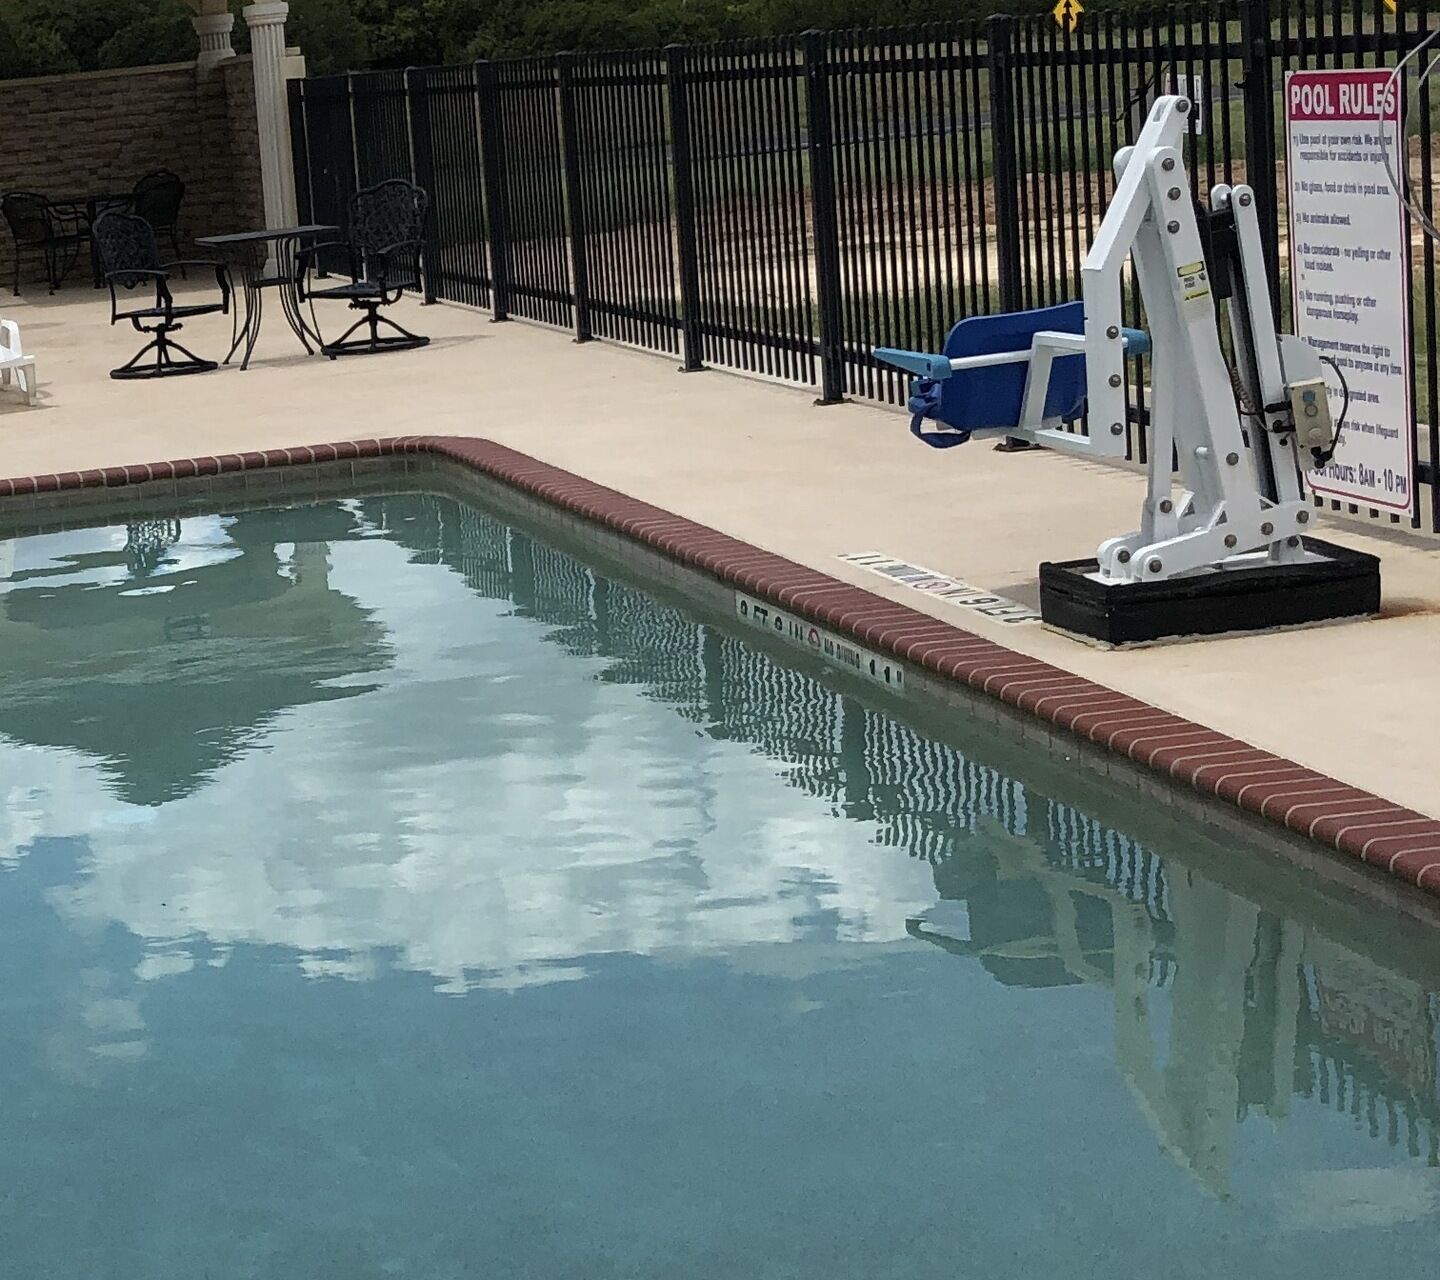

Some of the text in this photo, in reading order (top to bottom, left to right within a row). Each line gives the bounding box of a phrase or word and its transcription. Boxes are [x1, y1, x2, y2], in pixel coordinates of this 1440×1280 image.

[1291, 83, 1395, 115] POOL RULES
[1359, 463, 1375, 487] 8AM
[1384, 469, 1393, 491] 10
[1396, 475, 1406, 493] PM
